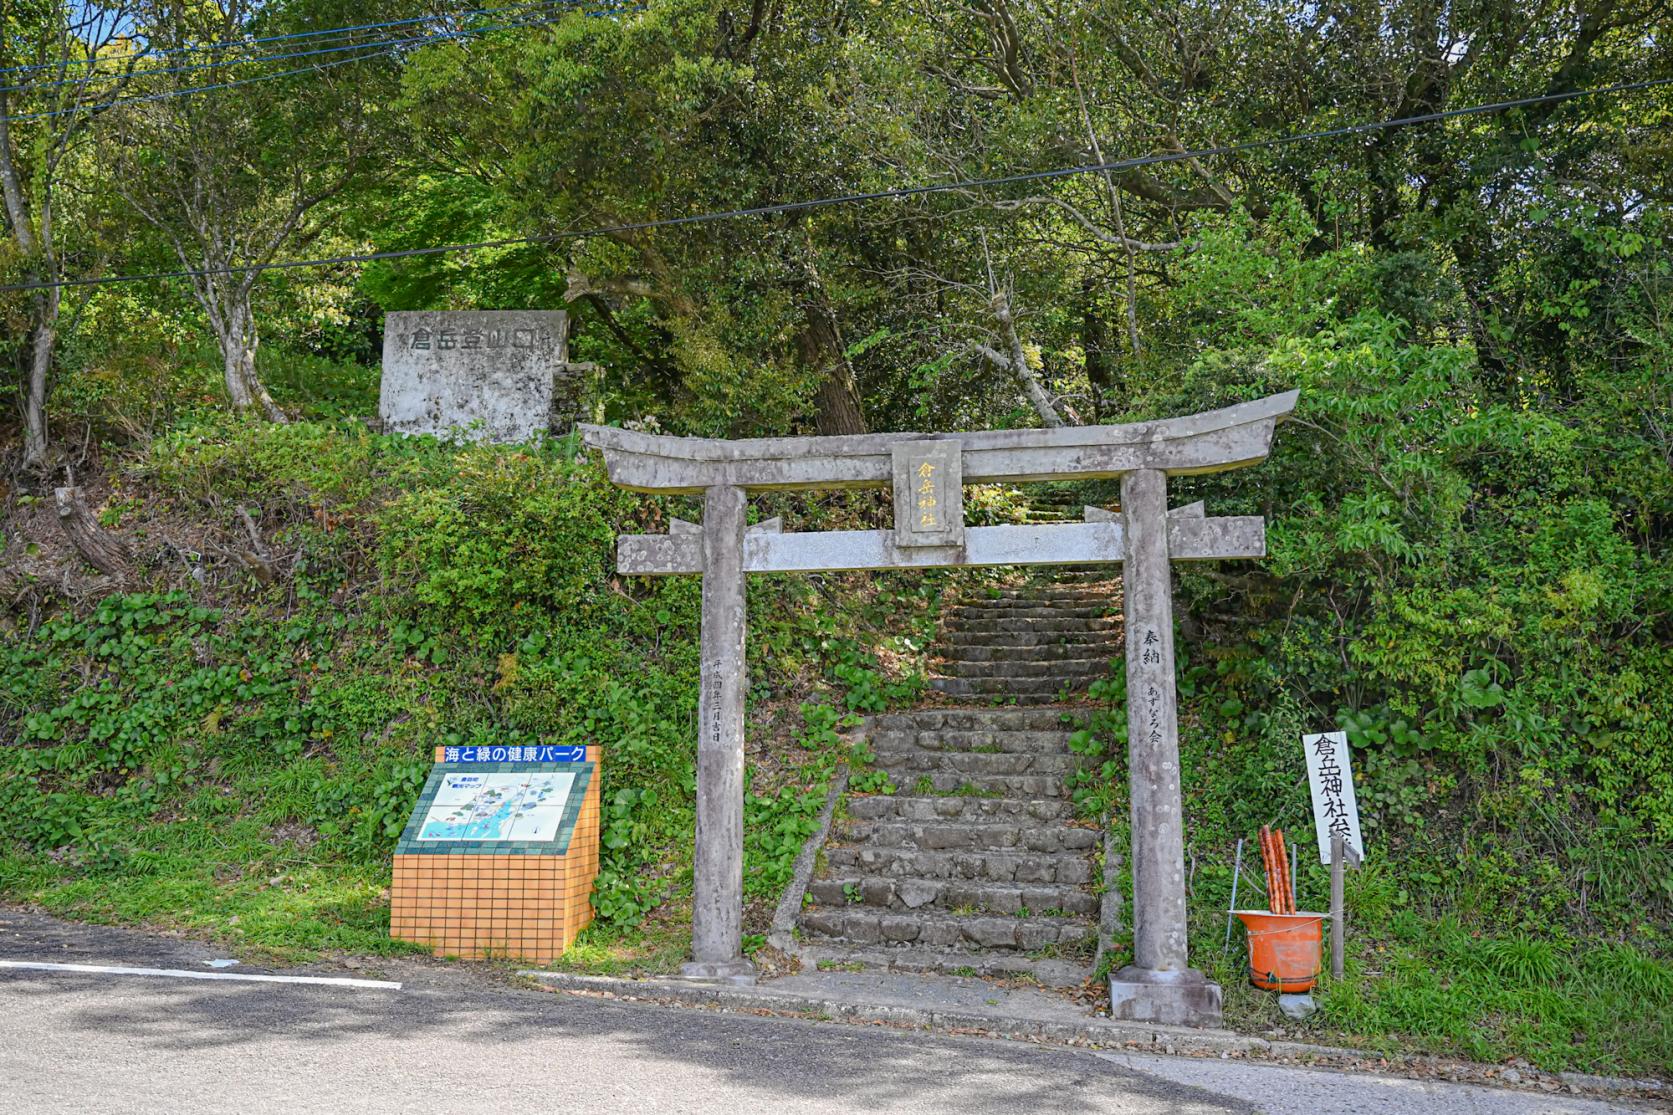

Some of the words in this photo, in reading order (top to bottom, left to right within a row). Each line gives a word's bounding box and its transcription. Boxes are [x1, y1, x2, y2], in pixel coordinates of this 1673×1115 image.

[411, 327, 534, 350] 倉岳登山口
[918, 462, 937, 528] 倉岳神社
[1143, 630, 1160, 664] 奉納
[445, 747, 585, 762] 海と緑の健康パーク
